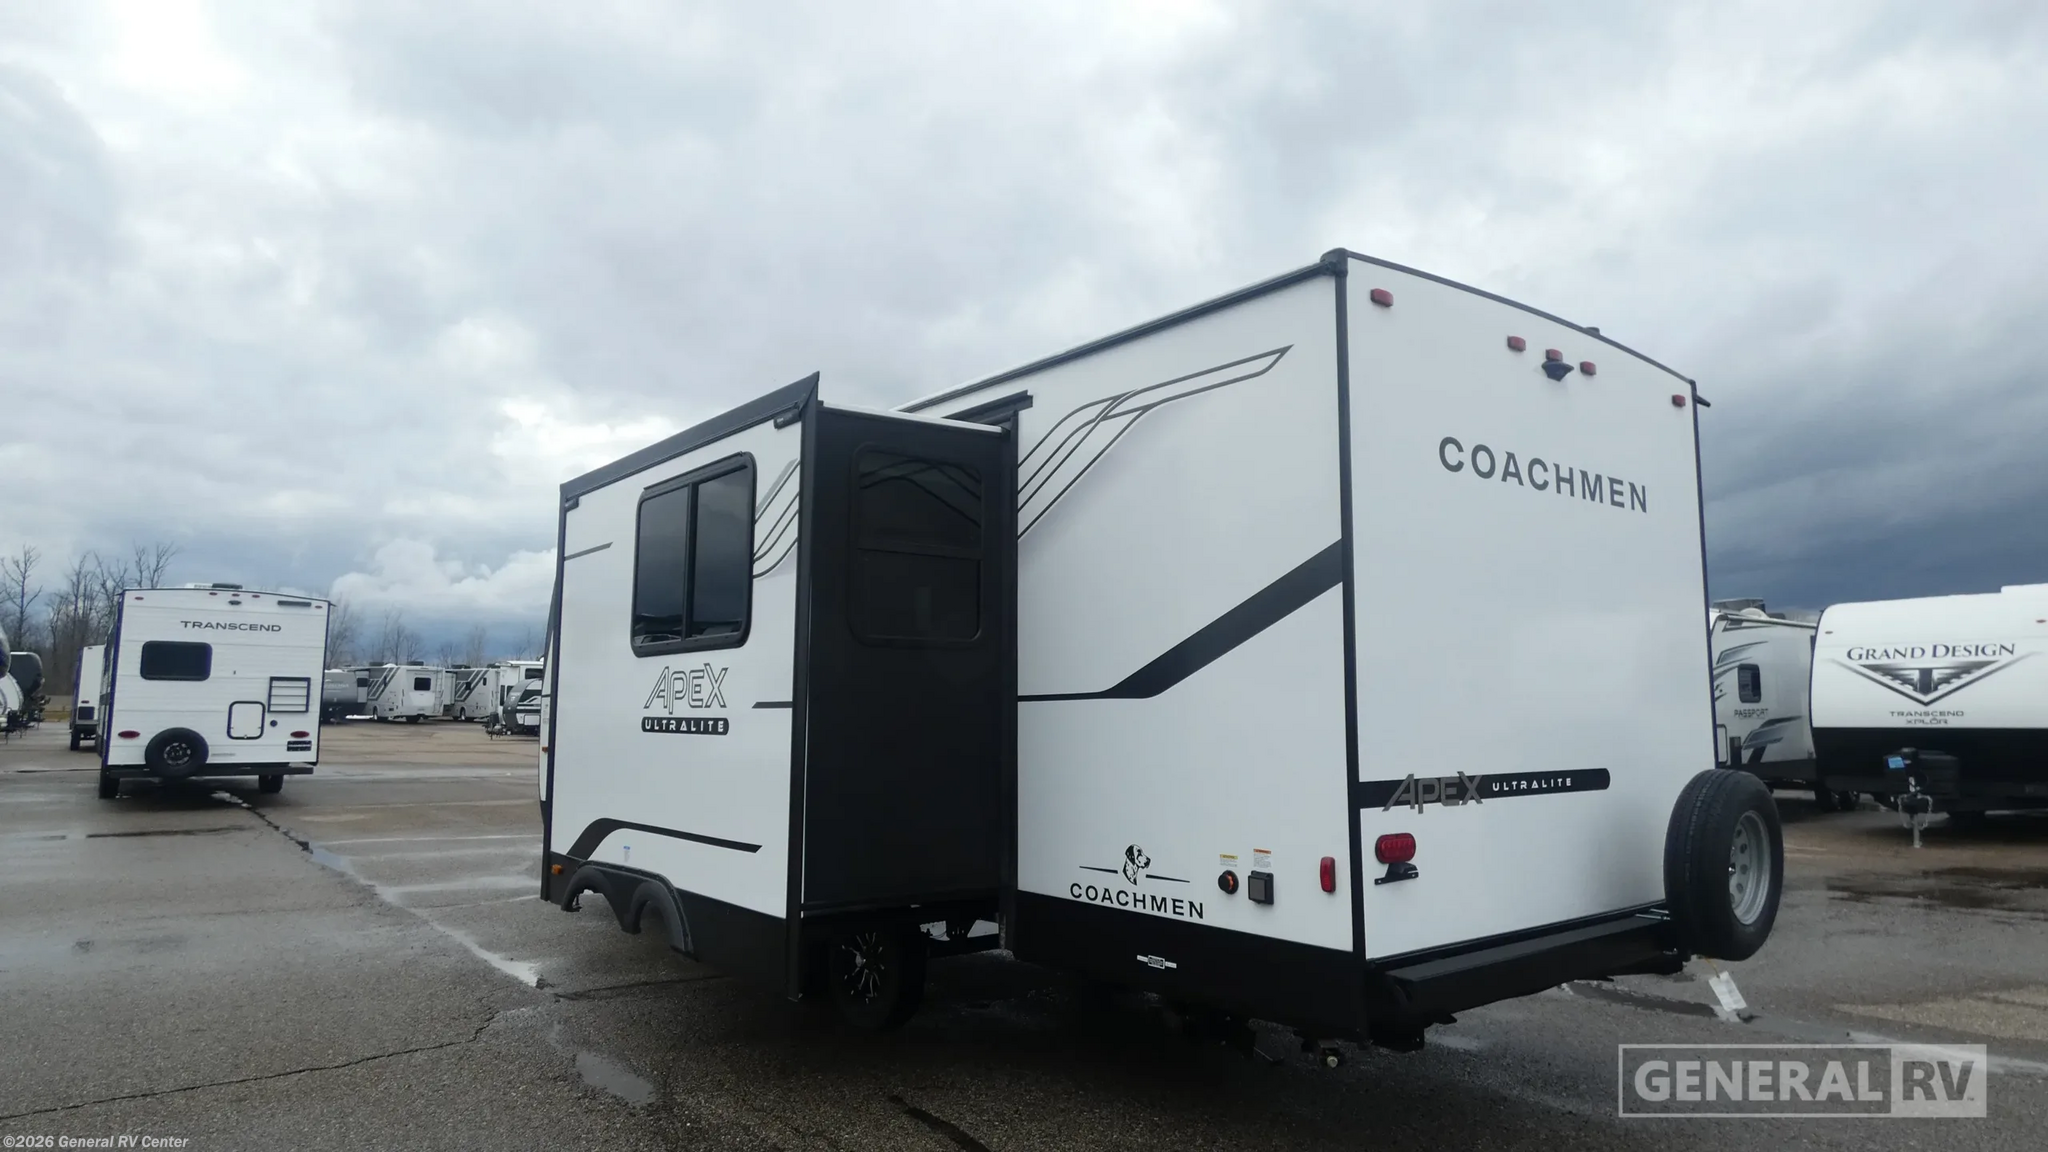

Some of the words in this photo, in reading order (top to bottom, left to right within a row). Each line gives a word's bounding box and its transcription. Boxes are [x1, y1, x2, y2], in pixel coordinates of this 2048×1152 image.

[1438, 436, 1648, 514] COACHMEN
[180, 620, 282, 632] TRANSCEND
[1846, 646, 1926, 661] GRAND
[1931, 643, 2016, 659] DESIGN
[645, 719, 724, 733] ULTRALITE
[1492, 777, 1572, 791] ULTRALITE
[1070, 882, 1204, 919] COACHMEN
